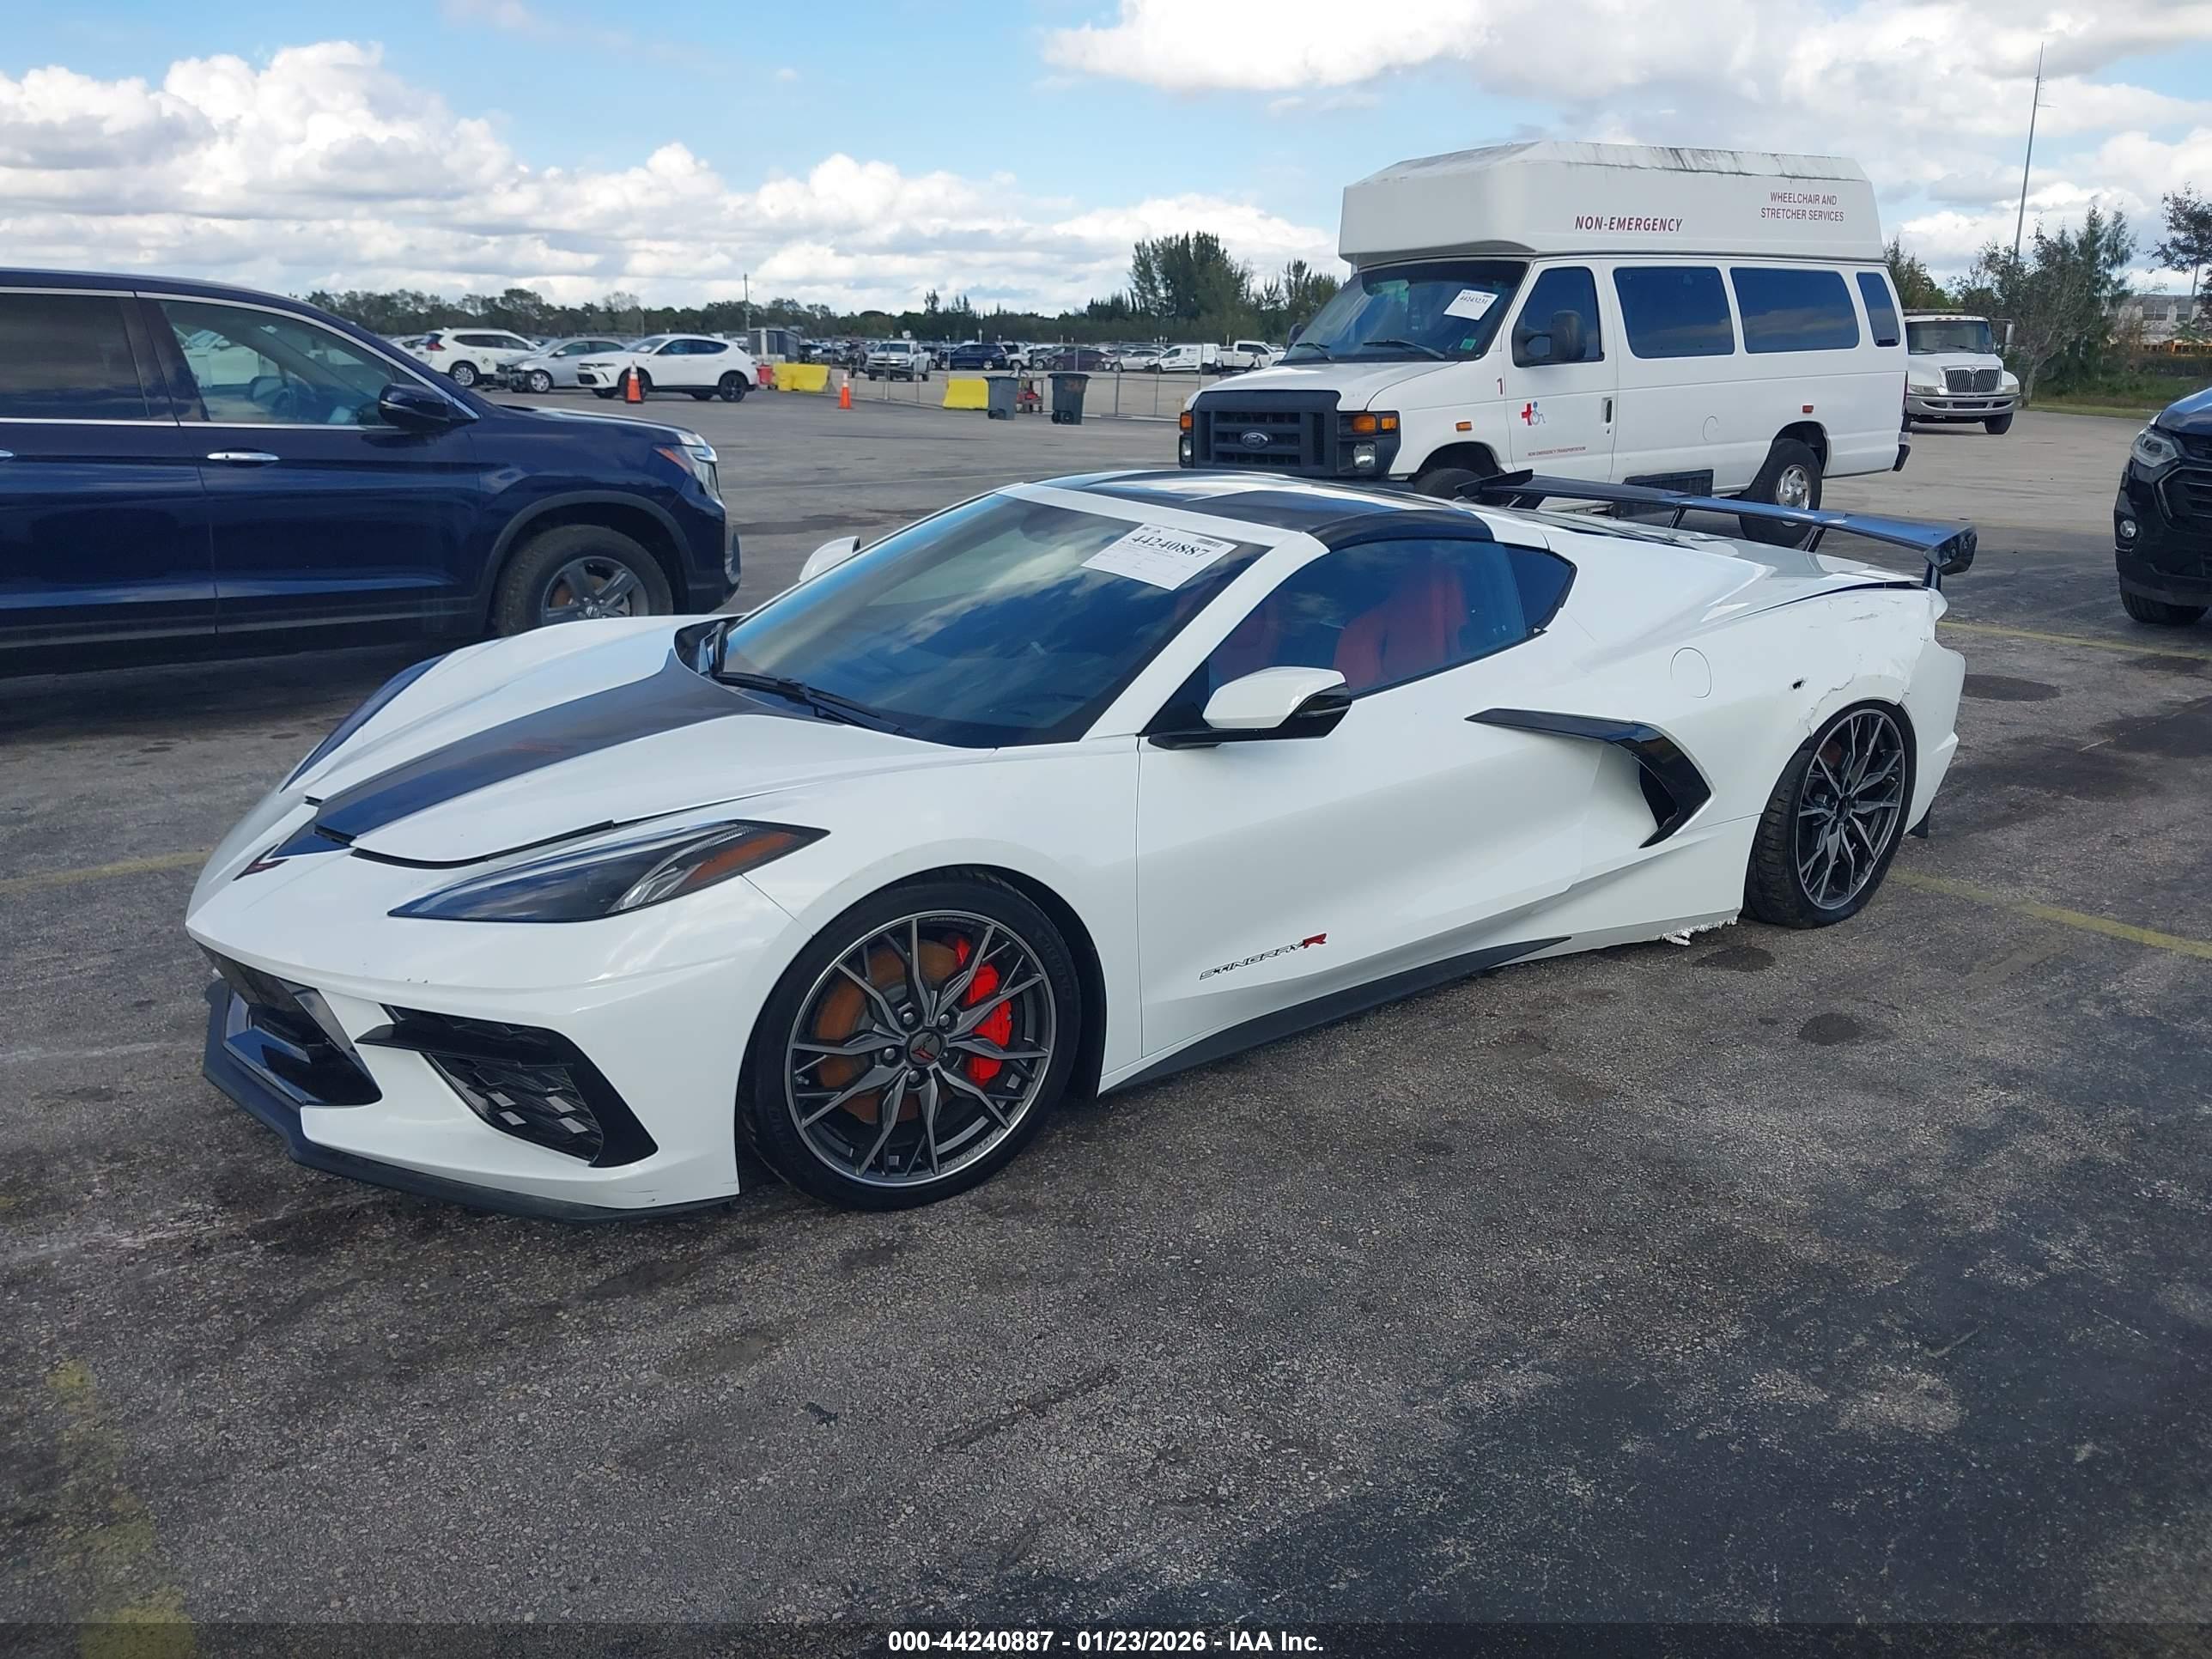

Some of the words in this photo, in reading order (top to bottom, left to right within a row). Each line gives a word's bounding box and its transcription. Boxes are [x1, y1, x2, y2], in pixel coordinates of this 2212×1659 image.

[1770, 191, 1820, 204] WHEELCHAIR
[1821, 195, 1838, 206] AND
[1760, 207, 1807, 220] STRETCHER
[1808, 210, 1844, 222] SERVICES
[1575, 216, 1683, 232] NON-EMERGENCY
[1497, 378, 1504, 395] 1
[1131, 535, 1210, 557] 44240887
